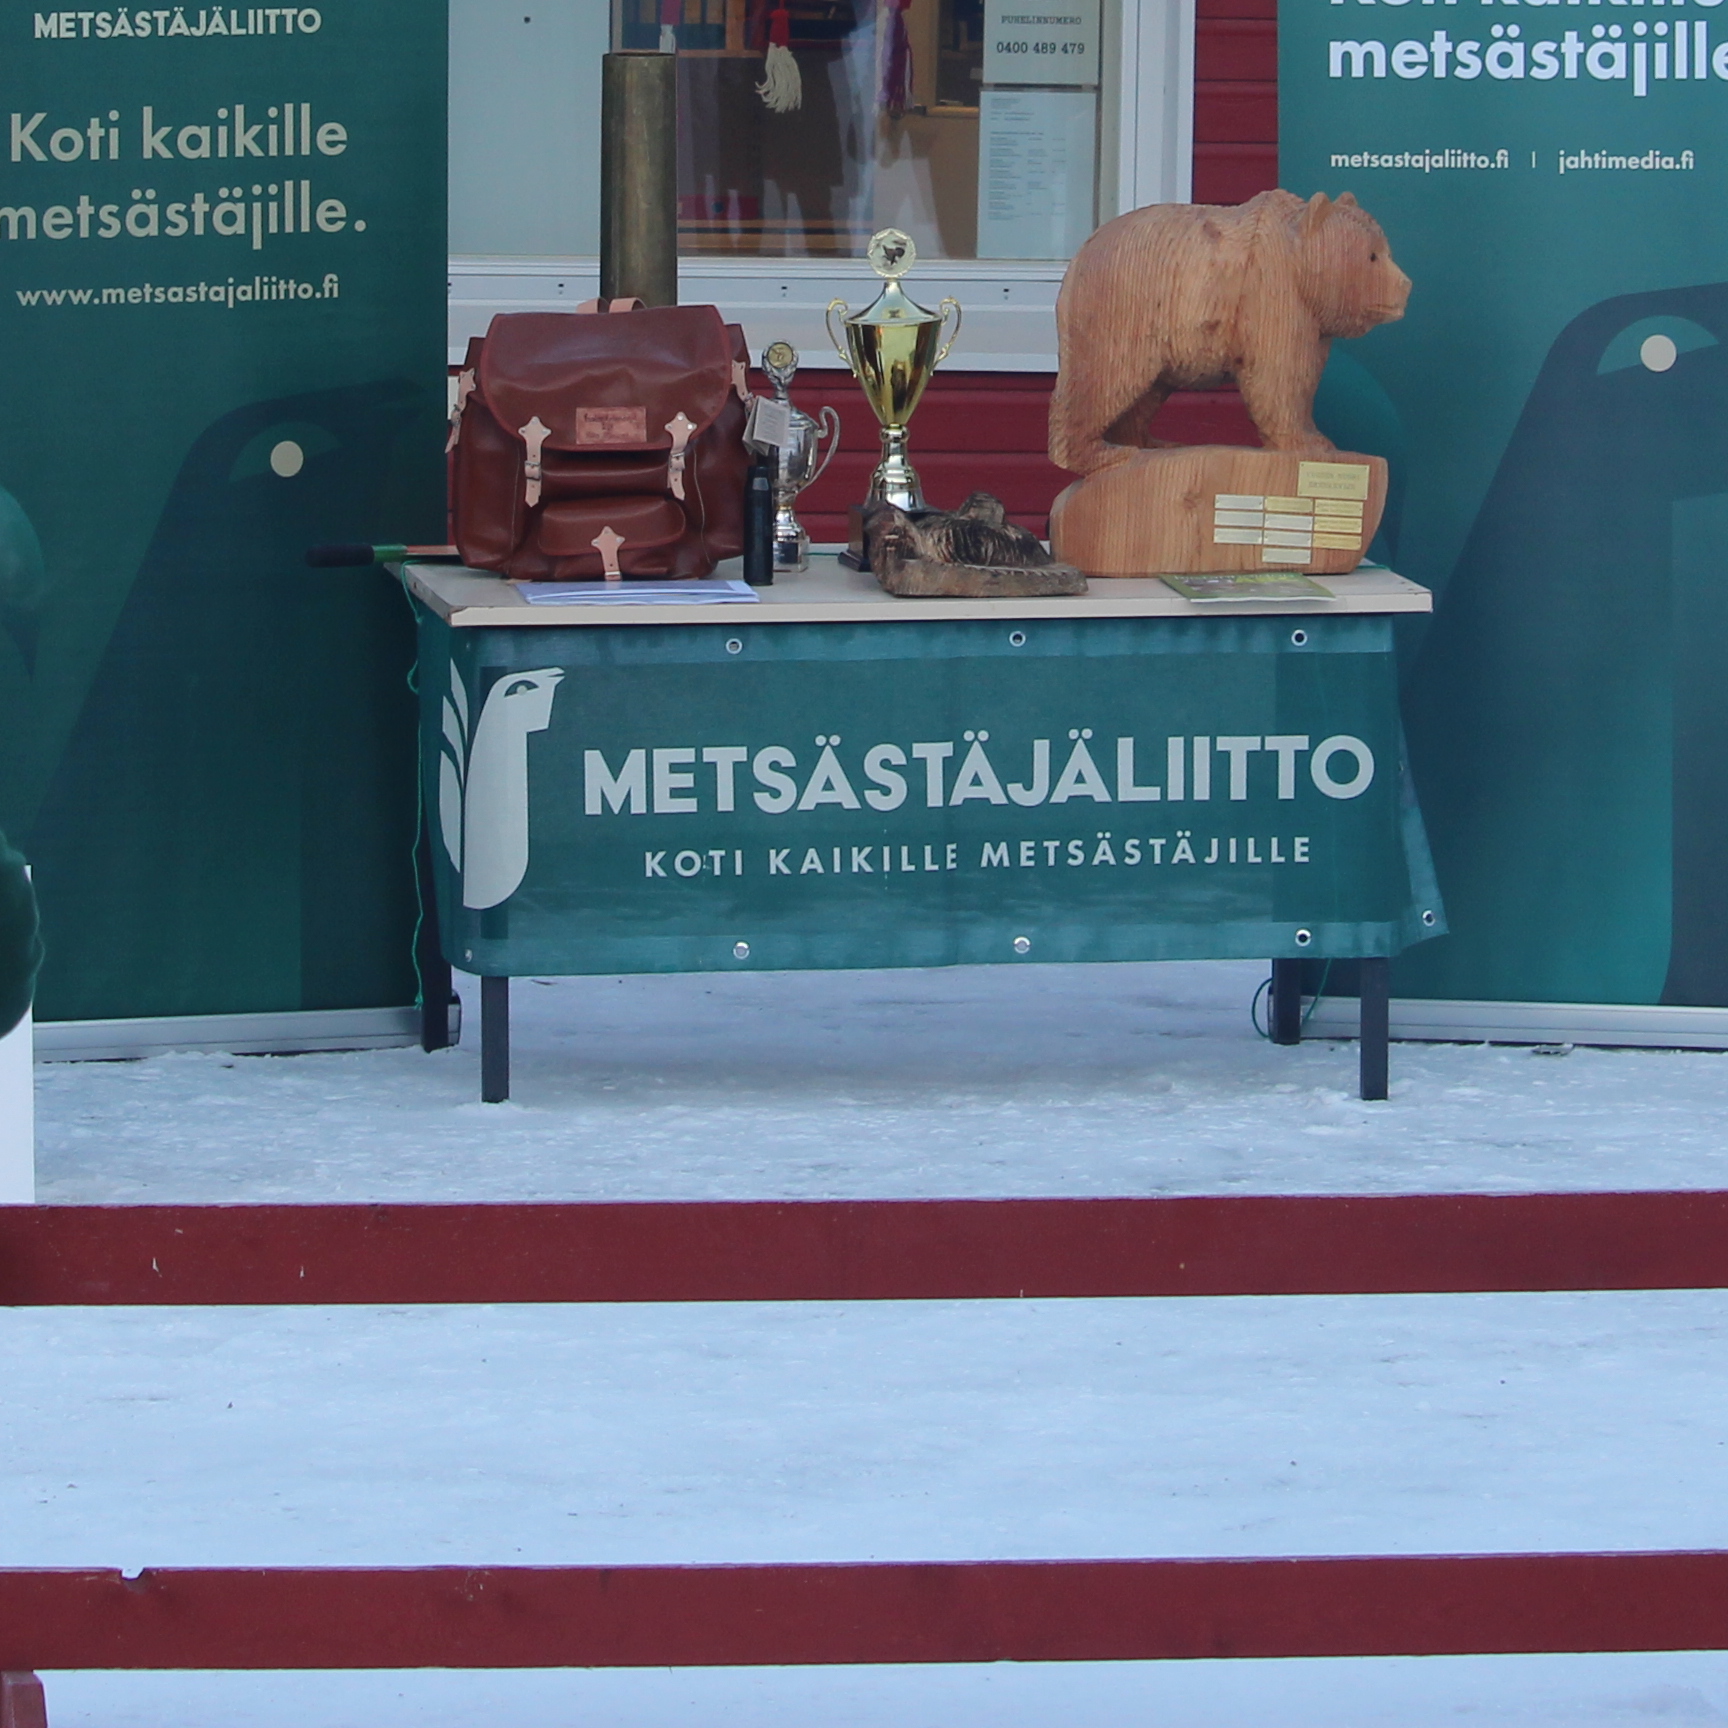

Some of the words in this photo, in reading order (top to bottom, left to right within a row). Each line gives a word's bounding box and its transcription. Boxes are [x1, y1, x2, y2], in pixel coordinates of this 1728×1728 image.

[34, 6, 323, 40] METSÄSTÄJÄLIITTO
[996, 41, 1029, 54] 0400
[1033, 42, 1057, 54] 489
[1061, 42, 1085, 55] 479
[10, 108, 120, 163] Koti
[141, 102, 349, 160] kaikille
[1329, 148, 1510, 174] metsastajaliitto.fi
[1558, 149, 1695, 175] jahtimedia.fi
[15, 273, 340, 310] www.metsastajaliitto.fi
[583, 728, 1376, 816] METSÄSTÄJÄLIITTO
[644, 848, 744, 879] KOTI
[768, 842, 958, 876] KAIKILLE
[979, 829, 1311, 869] METSÄSTÄJILLE
